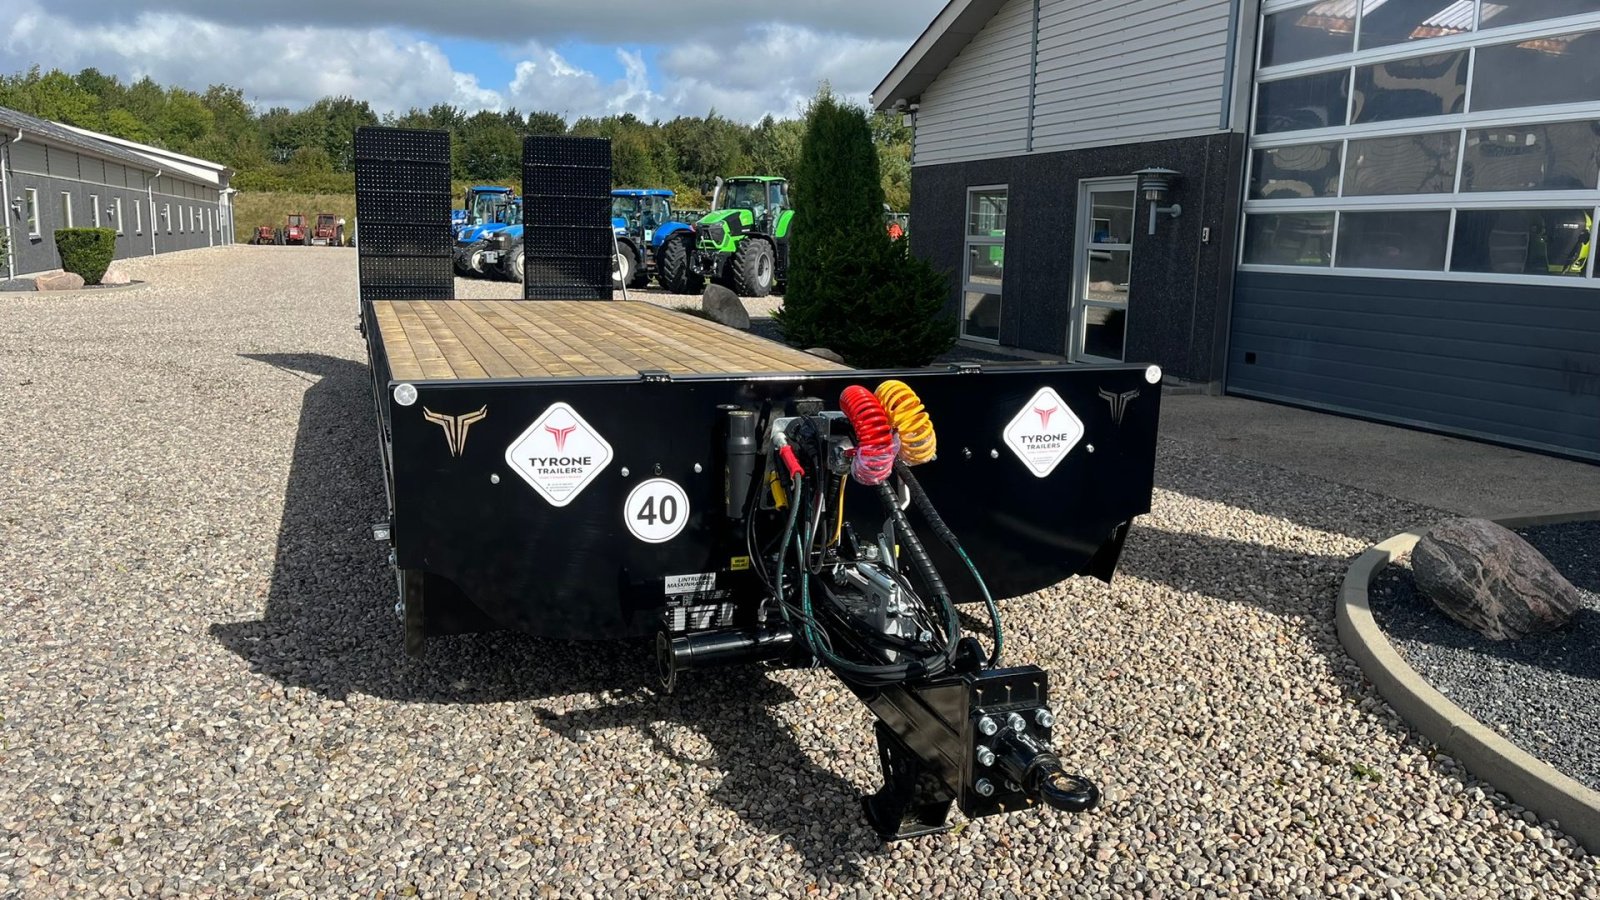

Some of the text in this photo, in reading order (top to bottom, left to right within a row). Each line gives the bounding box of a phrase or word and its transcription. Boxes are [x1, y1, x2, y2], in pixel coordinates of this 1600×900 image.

[1020, 433, 1068, 443] TYRONE
[528, 456, 592, 467] TYRONE
[537, 467, 583, 475] TRAILERS
[636, 495, 678, 525] 40
